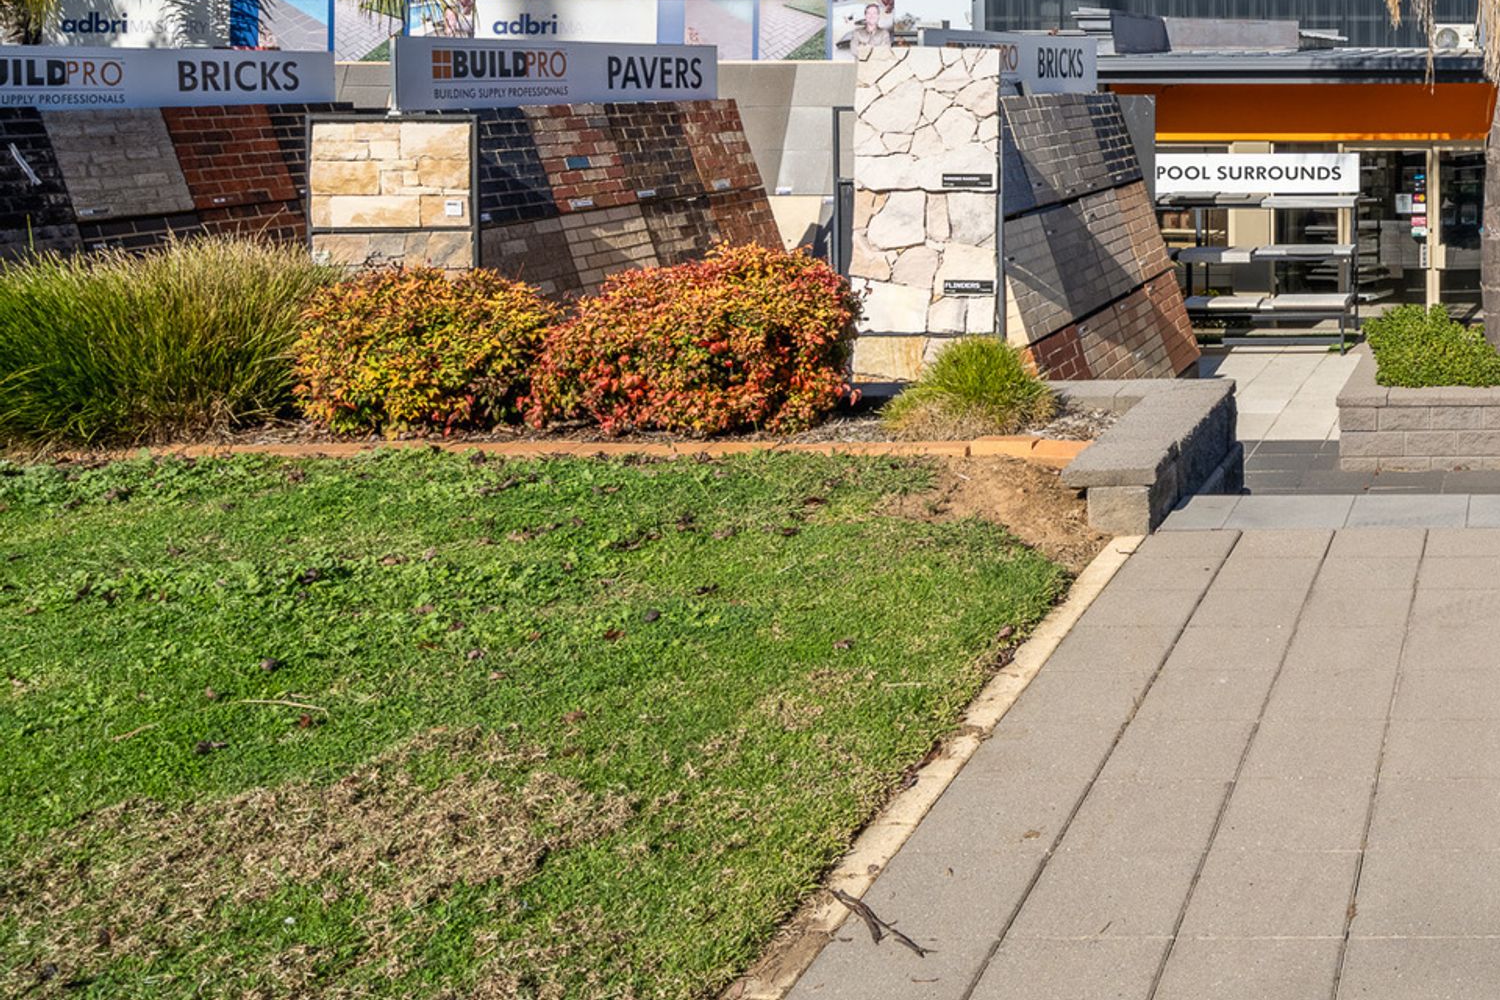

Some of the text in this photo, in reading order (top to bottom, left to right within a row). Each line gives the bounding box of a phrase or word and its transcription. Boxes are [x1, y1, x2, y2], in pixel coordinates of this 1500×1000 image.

[62, 12, 127, 33] adbri
[493, 14, 557, 34] adbri
[453, 50, 567, 77] BUILDPRO
[608, 56, 703, 89] PAVERS
[1037, 47, 1083, 78] BRICKS
[178, 60, 300, 92] BRICKS
[0, 94, 126, 105] UPPLY PROFESSIONALS
[434, 86, 569, 99] BUILDING SUPPLY PROFESSIONALS
[1156, 166, 1342, 180] POOL SURROUNDS
